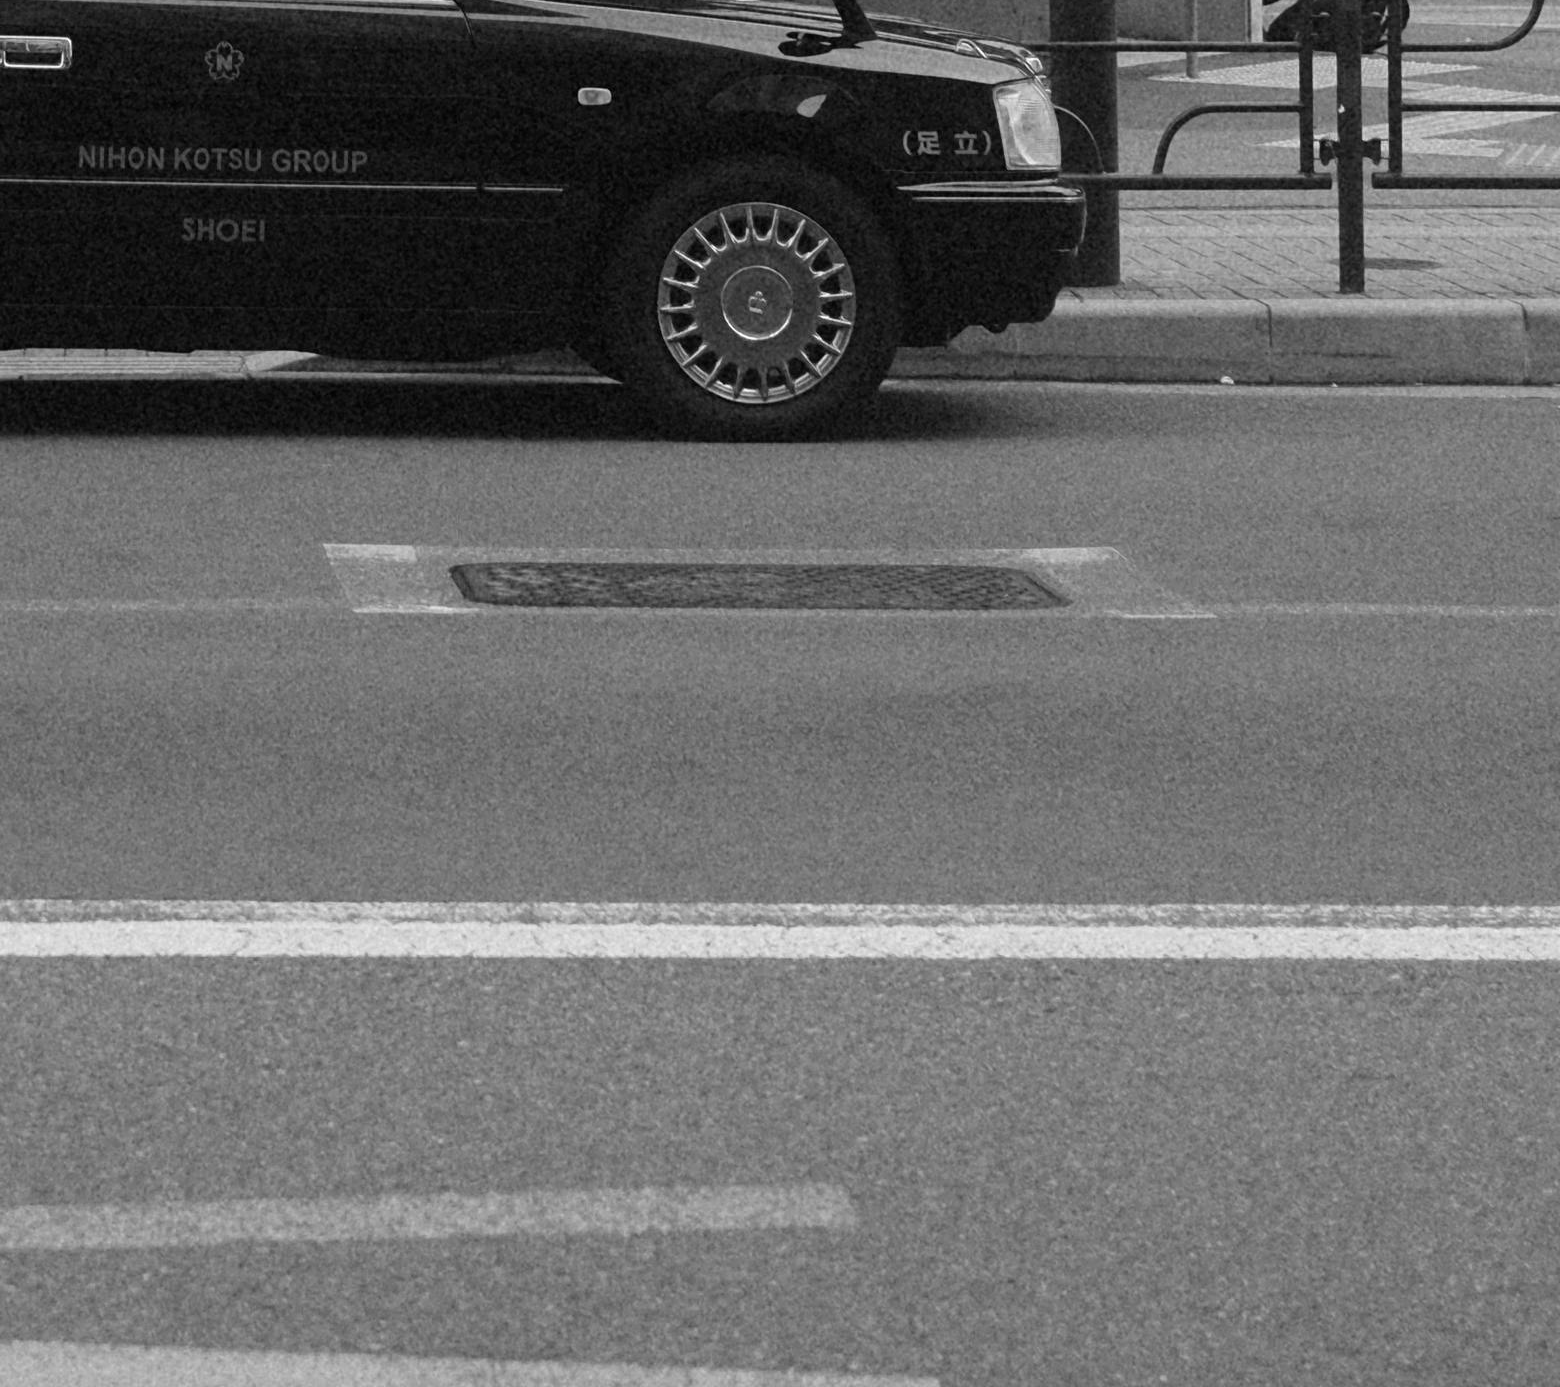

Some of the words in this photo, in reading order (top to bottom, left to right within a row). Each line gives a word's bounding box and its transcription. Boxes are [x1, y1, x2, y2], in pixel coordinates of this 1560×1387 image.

[79, 145, 165, 170] NIHON
[174, 146, 262, 172] KOTSU
[271, 148, 368, 174] GROUP
[181, 217, 266, 243] SHOEI
